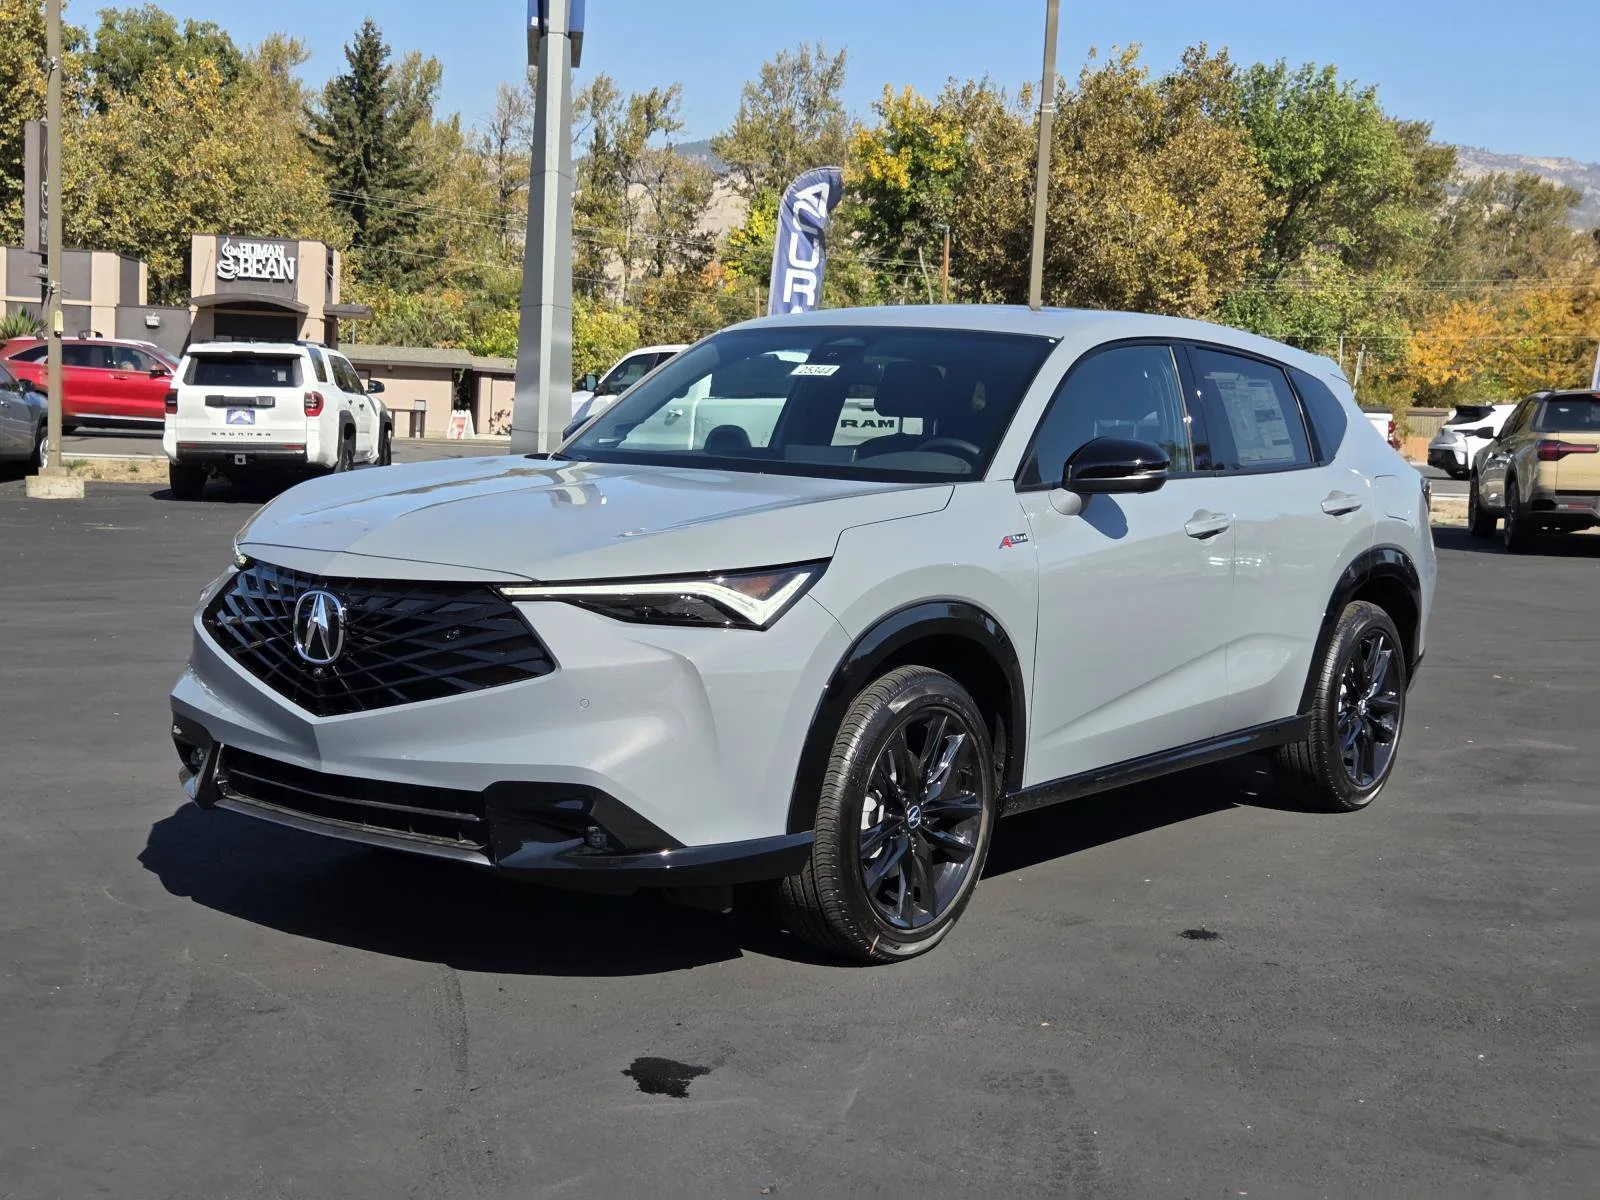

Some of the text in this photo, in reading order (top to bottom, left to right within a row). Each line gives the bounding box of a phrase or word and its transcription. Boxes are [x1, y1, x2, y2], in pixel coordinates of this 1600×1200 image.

[239, 243, 286, 260] HUMAN
[783, 182, 830, 314] ACUR
[237, 257, 296, 280] BEAN
[841, 419, 895, 428] RAM
